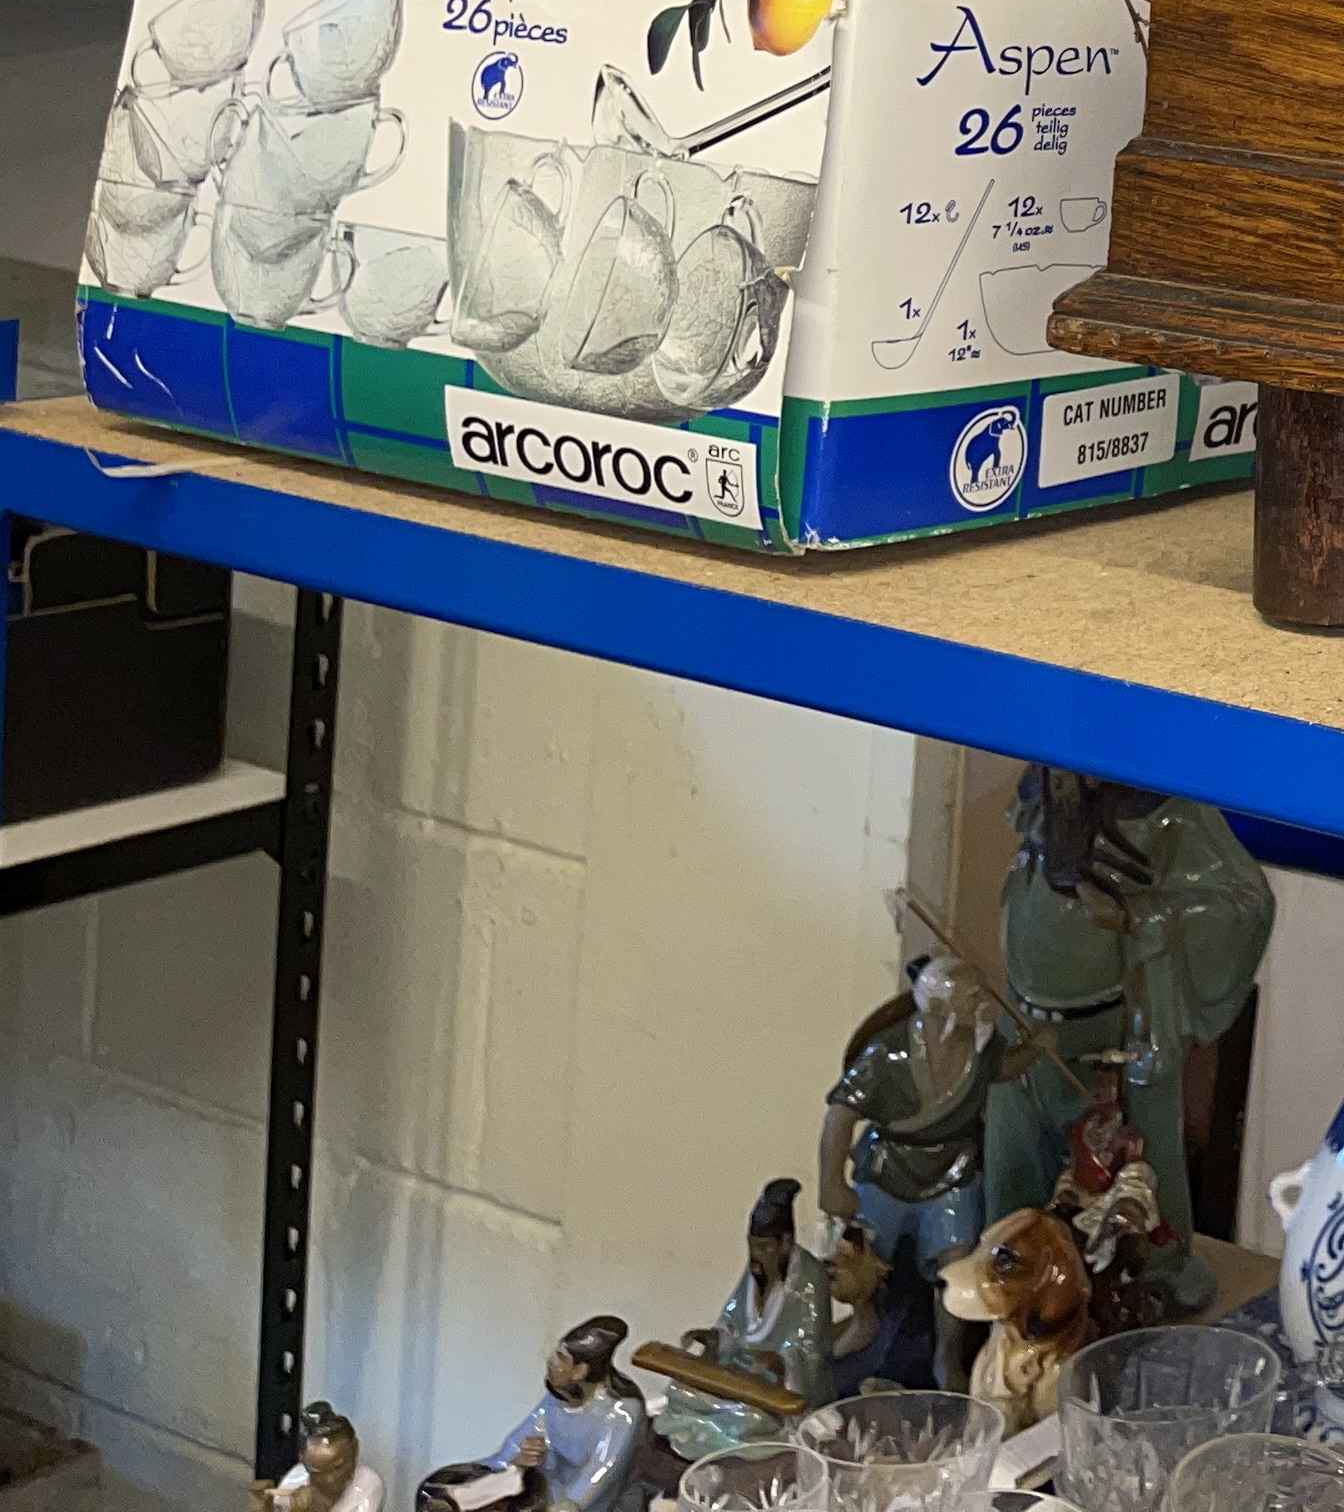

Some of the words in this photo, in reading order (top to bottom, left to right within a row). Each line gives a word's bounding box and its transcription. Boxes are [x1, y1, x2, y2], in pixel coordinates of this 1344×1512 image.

[493, 12, 568, 46] pièces
[1032, 104, 1077, 122] pieces
[954, 104, 1024, 156] 26
[1036, 119, 1069, 138] teilig
[1033, 136, 1068, 155] delig
[1063, 403, 1092, 427] CAT
[1100, 389, 1167, 420] NUMBER
[708, 443, 741, 463] arc
[1077, 432, 1150, 465] 815/8837
